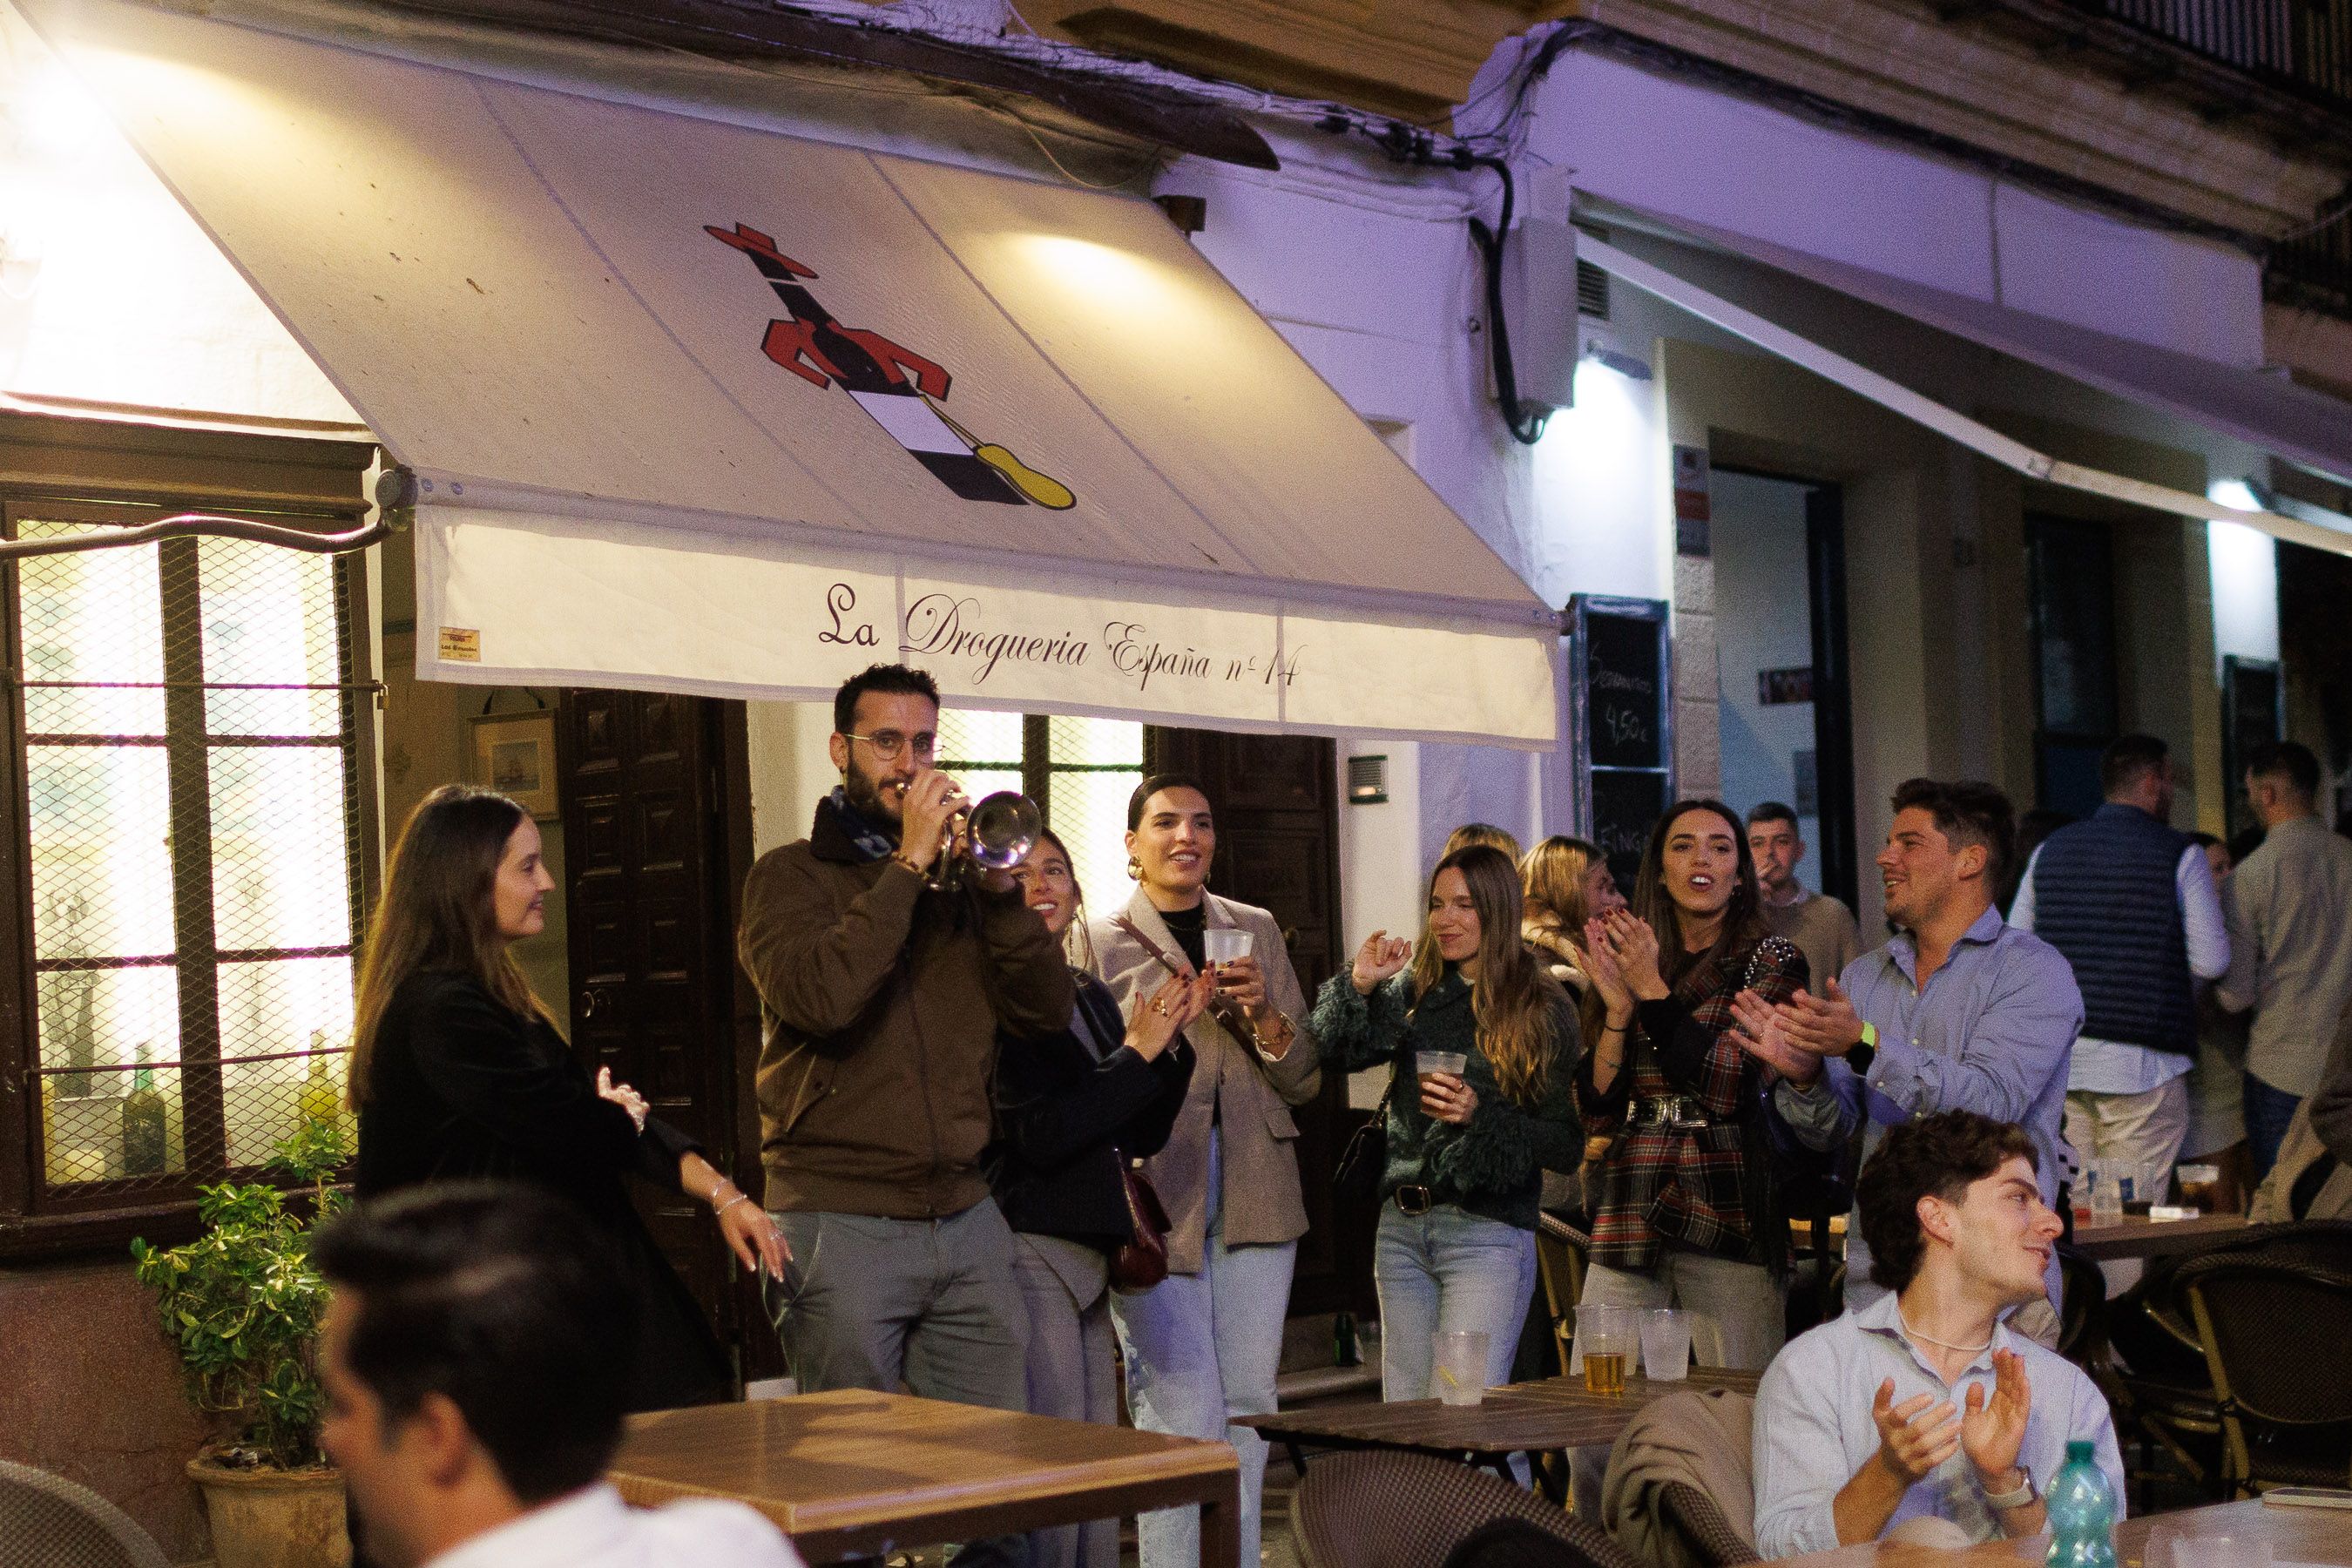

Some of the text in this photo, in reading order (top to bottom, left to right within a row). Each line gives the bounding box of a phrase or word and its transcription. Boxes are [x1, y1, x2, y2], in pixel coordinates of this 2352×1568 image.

[818, 583, 881, 646] La
[898, 593, 1091, 686] Drogueria
[1104, 621, 1212, 691] España
[1263, 644, 1309, 686] 14
